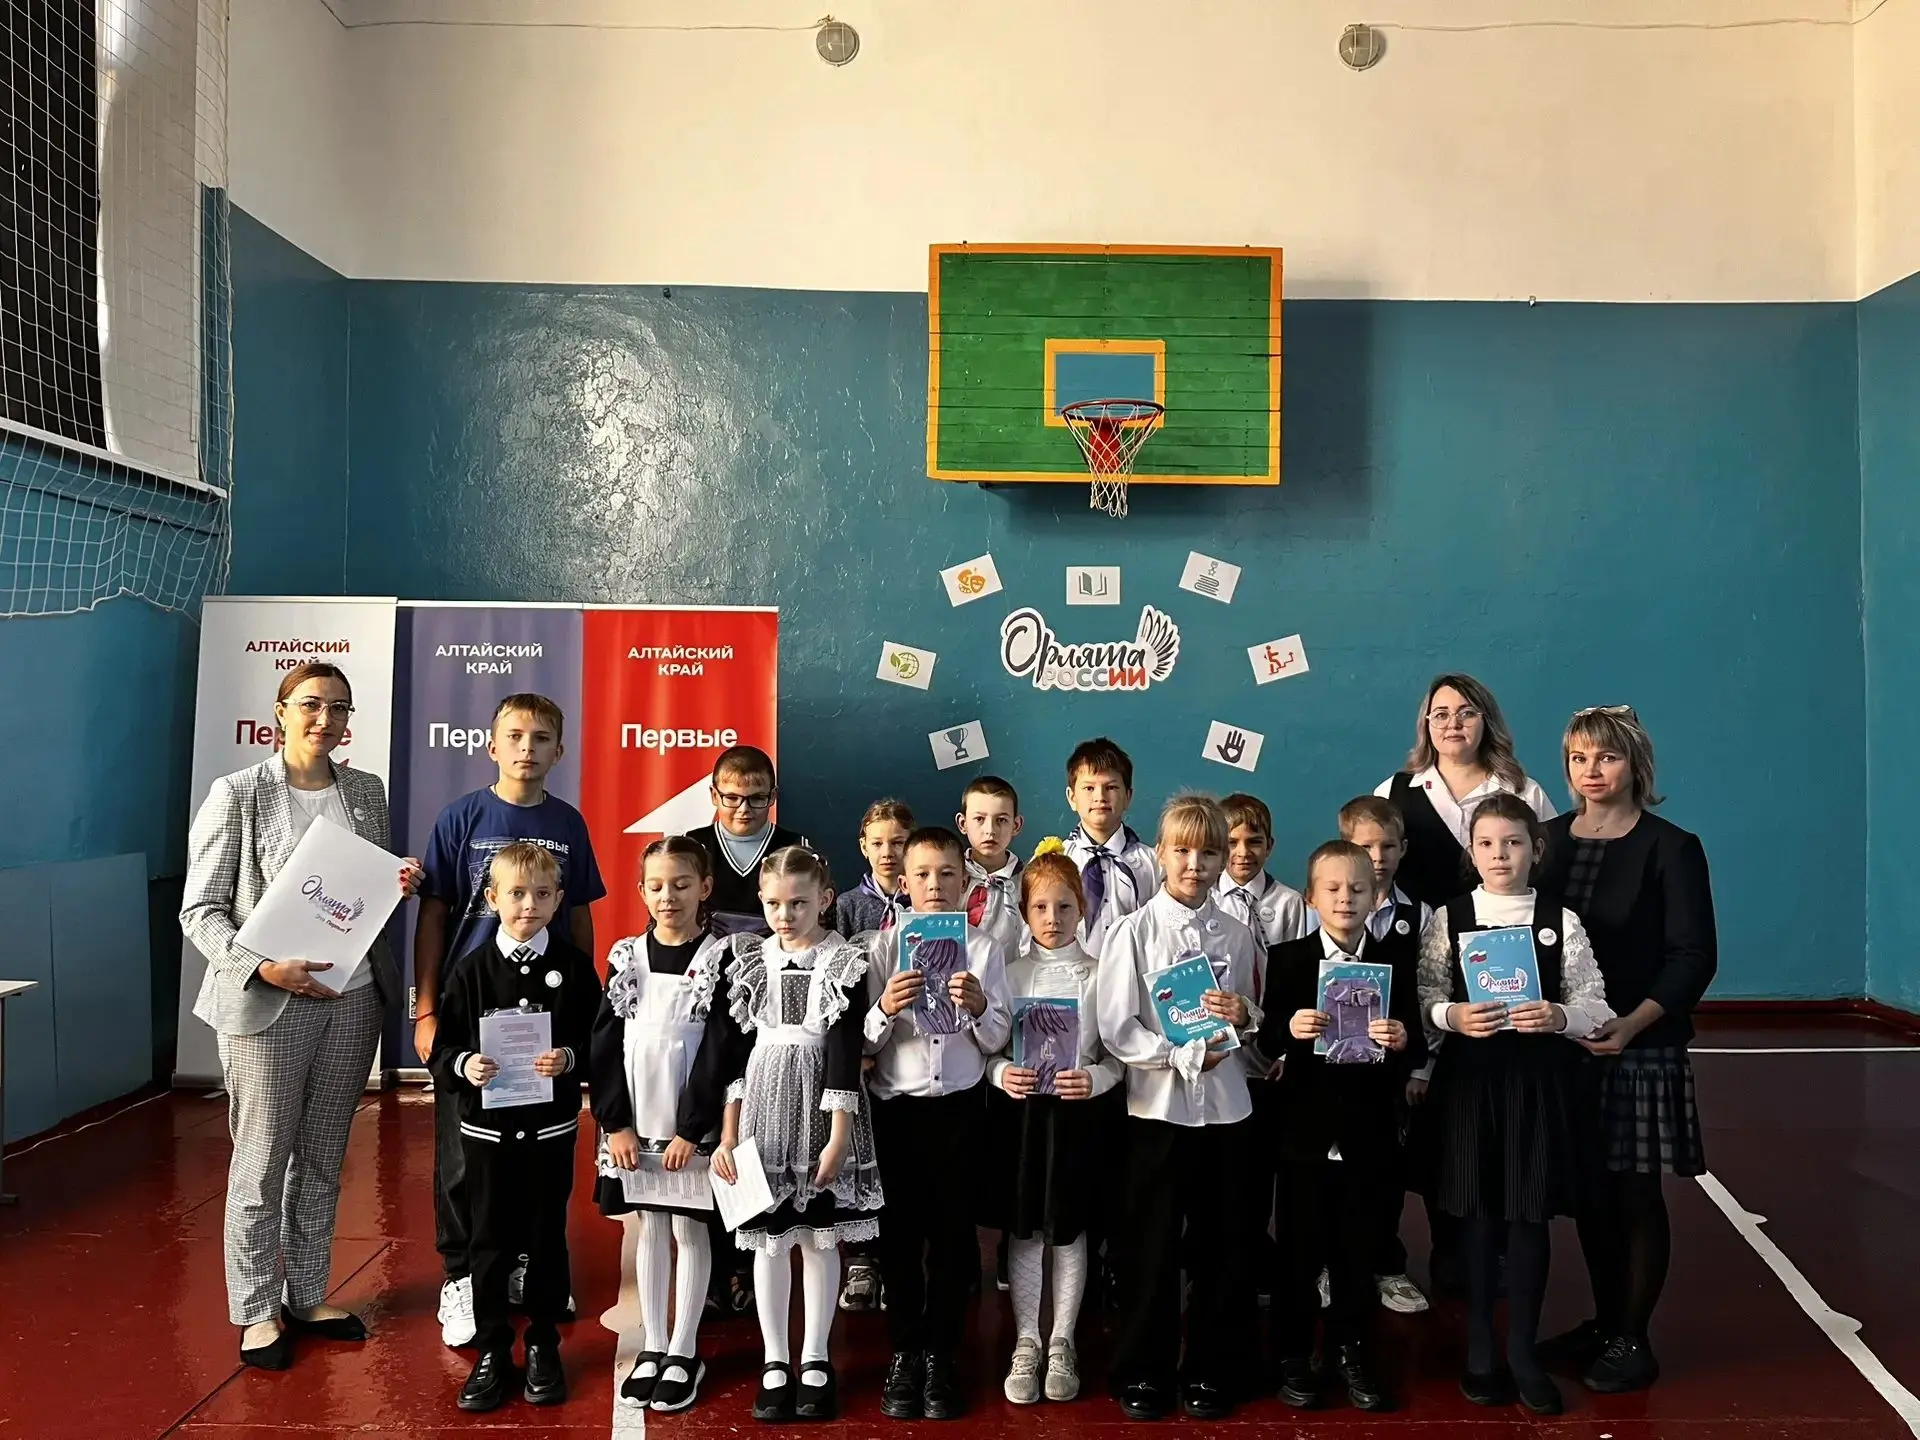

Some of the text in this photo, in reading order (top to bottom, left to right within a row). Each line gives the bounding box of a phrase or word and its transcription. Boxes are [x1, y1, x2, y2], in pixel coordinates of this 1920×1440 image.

[245, 638, 350, 653] АЛТАЙСКИЙ
[435, 642, 543, 657] АЛТАЙСКИЙ
[627, 644, 734, 659] АЛТАЙСКИЙ
[1005, 611, 1146, 684] Орлята
[465, 660, 513, 674] КРАЙ
[657, 661, 704, 676] КРАЙ
[1041, 667, 1146, 687] РОССИИ
[236, 719, 352, 753] Пере
[621, 723, 738, 755] Первые
